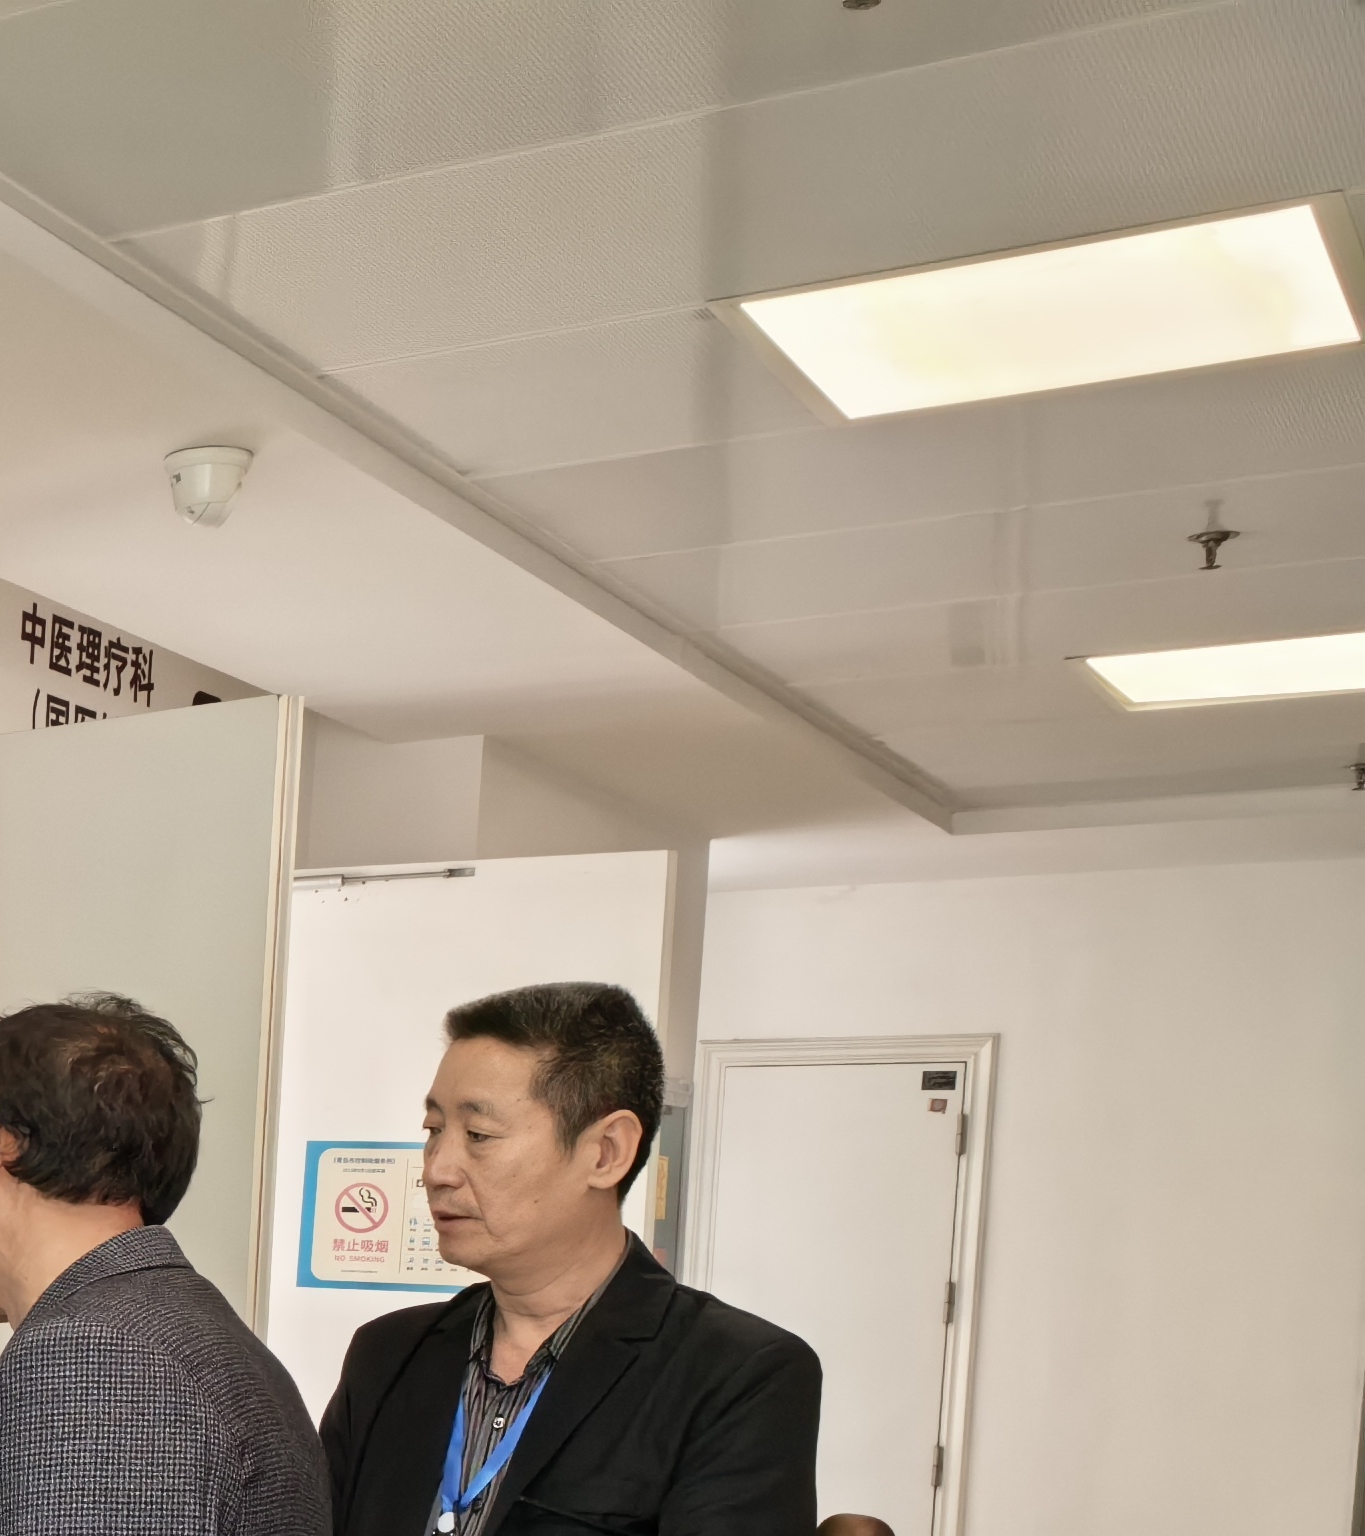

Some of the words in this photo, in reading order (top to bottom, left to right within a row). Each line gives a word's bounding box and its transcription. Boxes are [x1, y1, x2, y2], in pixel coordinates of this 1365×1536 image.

[20, 602, 155, 708] 中医理疗科
[332, 1238, 389, 1254] 禁止吸烟
[334, 1254, 346, 1262] NO
[349, 1255, 385, 1263] SMOKING
